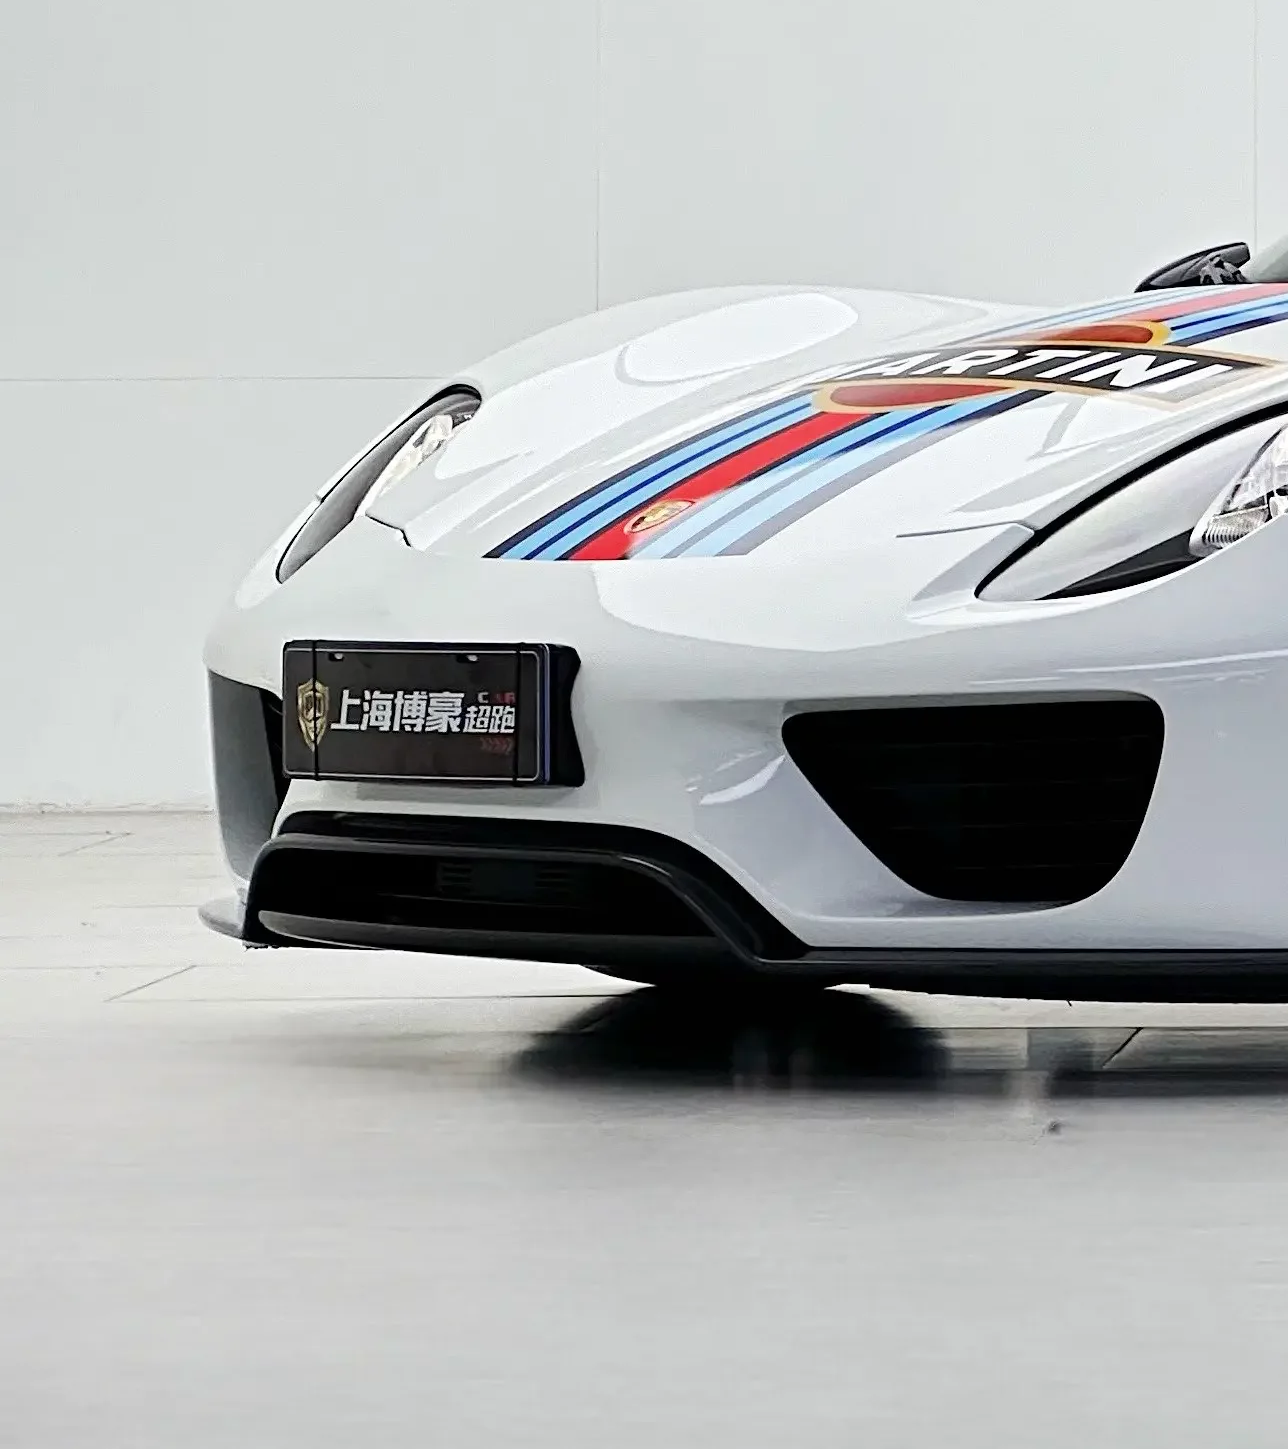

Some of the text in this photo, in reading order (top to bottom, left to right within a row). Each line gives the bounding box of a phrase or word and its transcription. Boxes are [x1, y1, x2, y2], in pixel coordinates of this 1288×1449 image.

[330, 688, 465, 734] 上海博豪
[462, 705, 516, 734] 超跑
